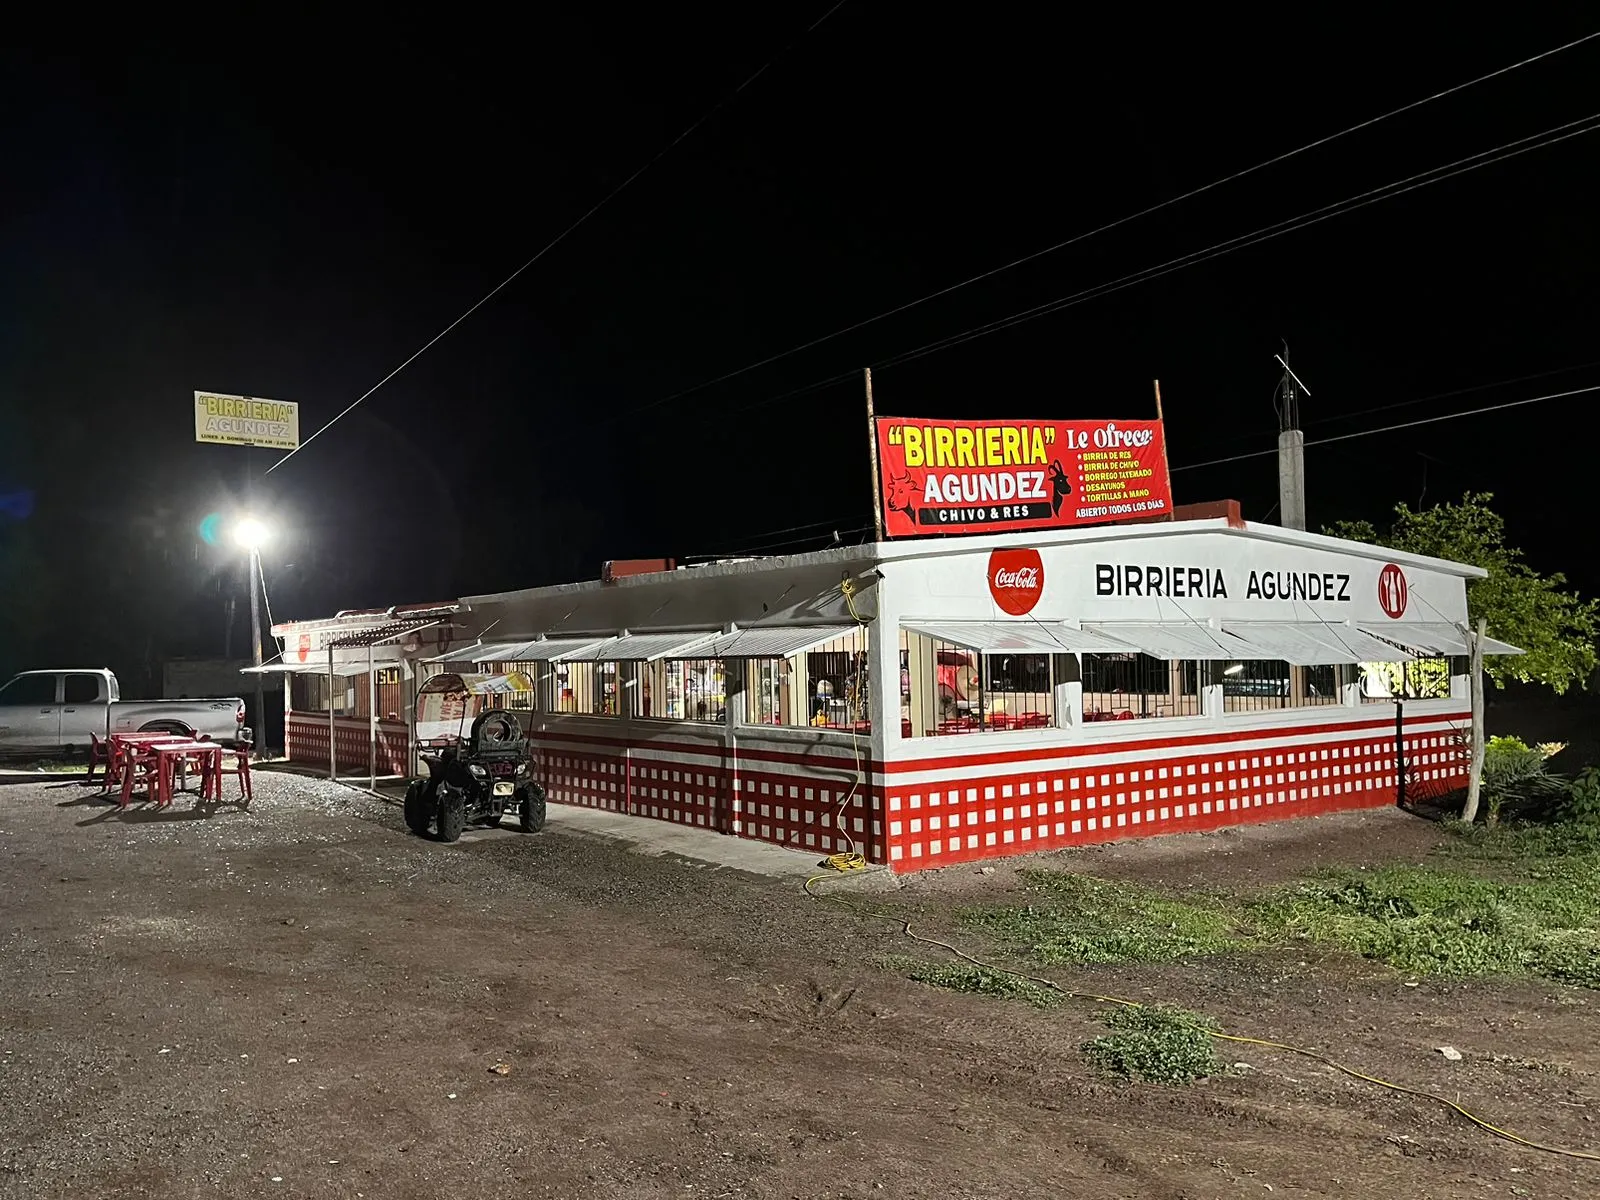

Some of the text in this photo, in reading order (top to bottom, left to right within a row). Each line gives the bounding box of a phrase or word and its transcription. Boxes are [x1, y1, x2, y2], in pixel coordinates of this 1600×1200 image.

[206, 417, 290, 438] AGUNDEZ
[888, 425, 1056, 467] “BIRRIERIA”
[1066, 429, 1089, 449] Le
[1083, 451, 1132, 461] BIRRIA DE RES
[1084, 460, 1139, 471] BIRRIA DE CHIVO
[1085, 468, 1152, 481] BORREGO TATEMADO
[923, 471, 1047, 503] AGUNDEZ
[1086, 481, 1126, 492] DESAYUNOS
[1087, 488, 1149, 502] TORTILLAS A MANO
[939, 505, 1029, 522] CHIVO & RES
[1076, 506, 1107, 518] ABIERTO
[1108, 504, 1132, 515] TODOS
[1132, 502, 1146, 513] LOS
[994, 567, 1039, 588] Coca-Cola
[1095, 563, 1350, 601] BIRRIERIA AGUNDEZ
